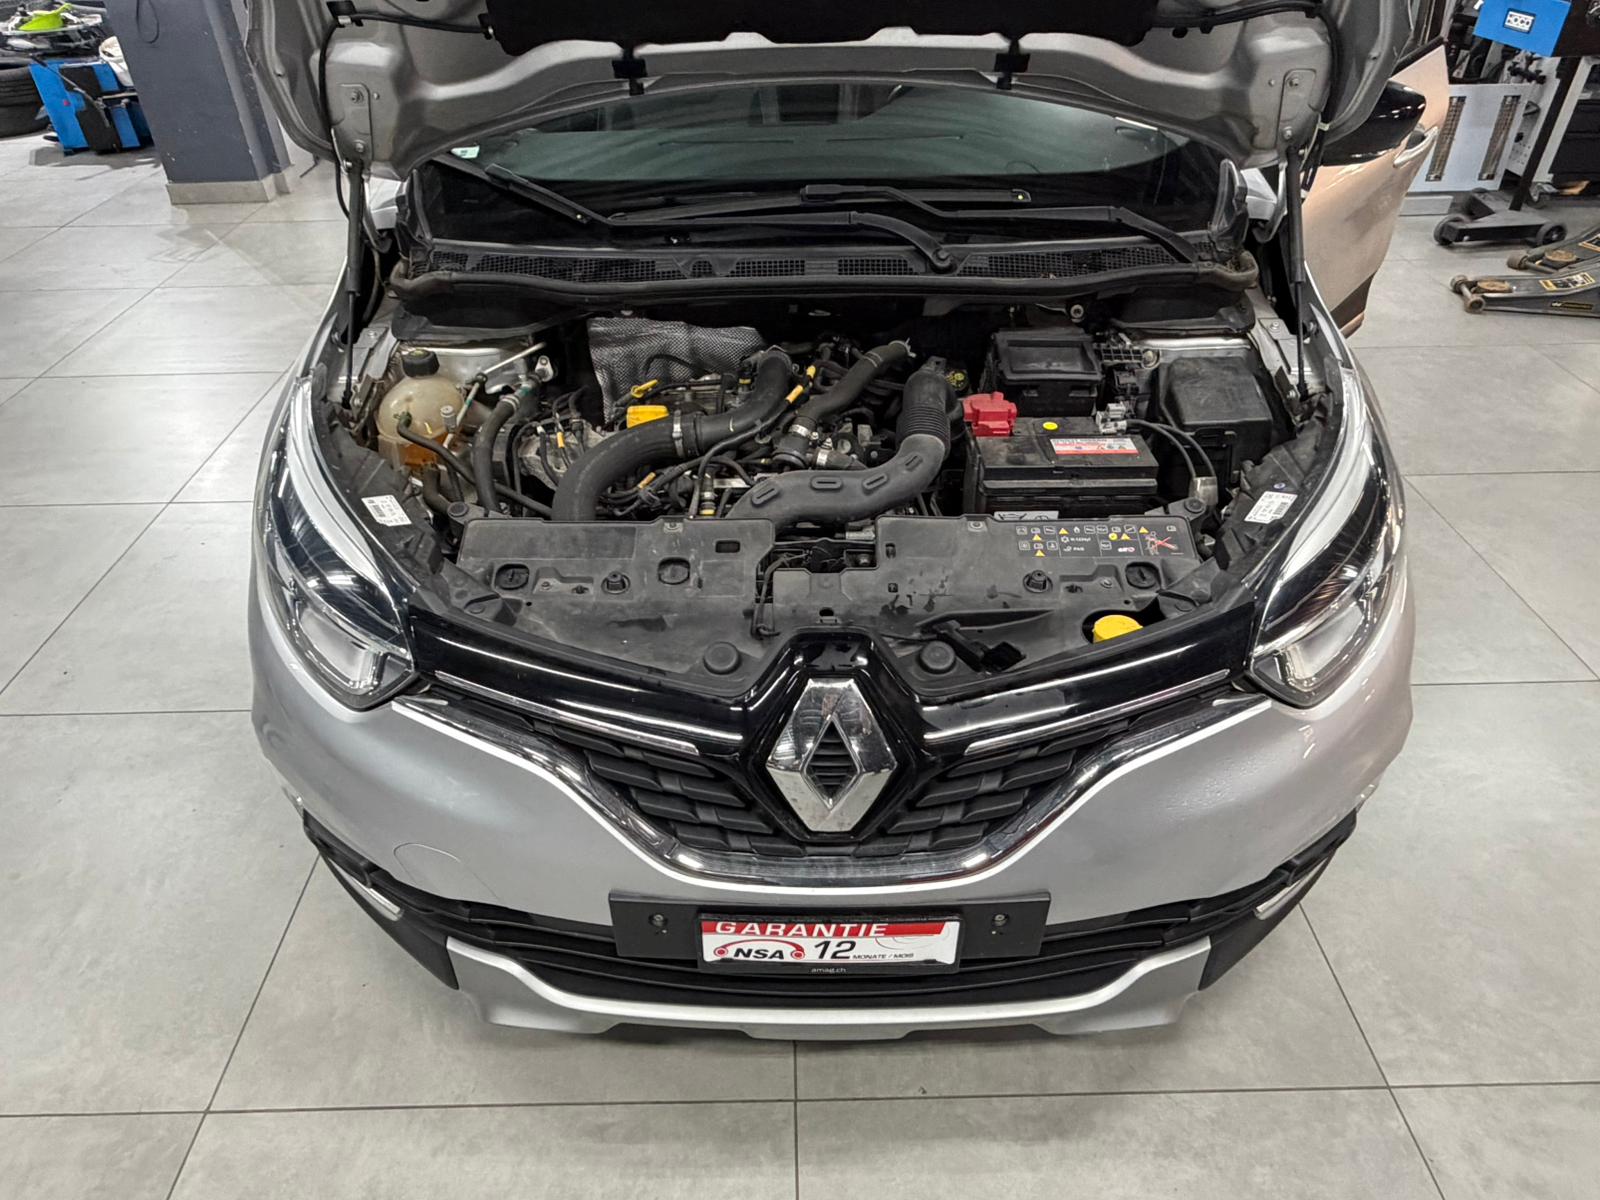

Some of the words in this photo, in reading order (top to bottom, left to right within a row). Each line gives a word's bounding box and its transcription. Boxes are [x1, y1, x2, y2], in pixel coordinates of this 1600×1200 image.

[715, 921, 889, 938] GARANTIE
[733, 948, 784, 960] NSA
[814, 940, 856, 960] 12
